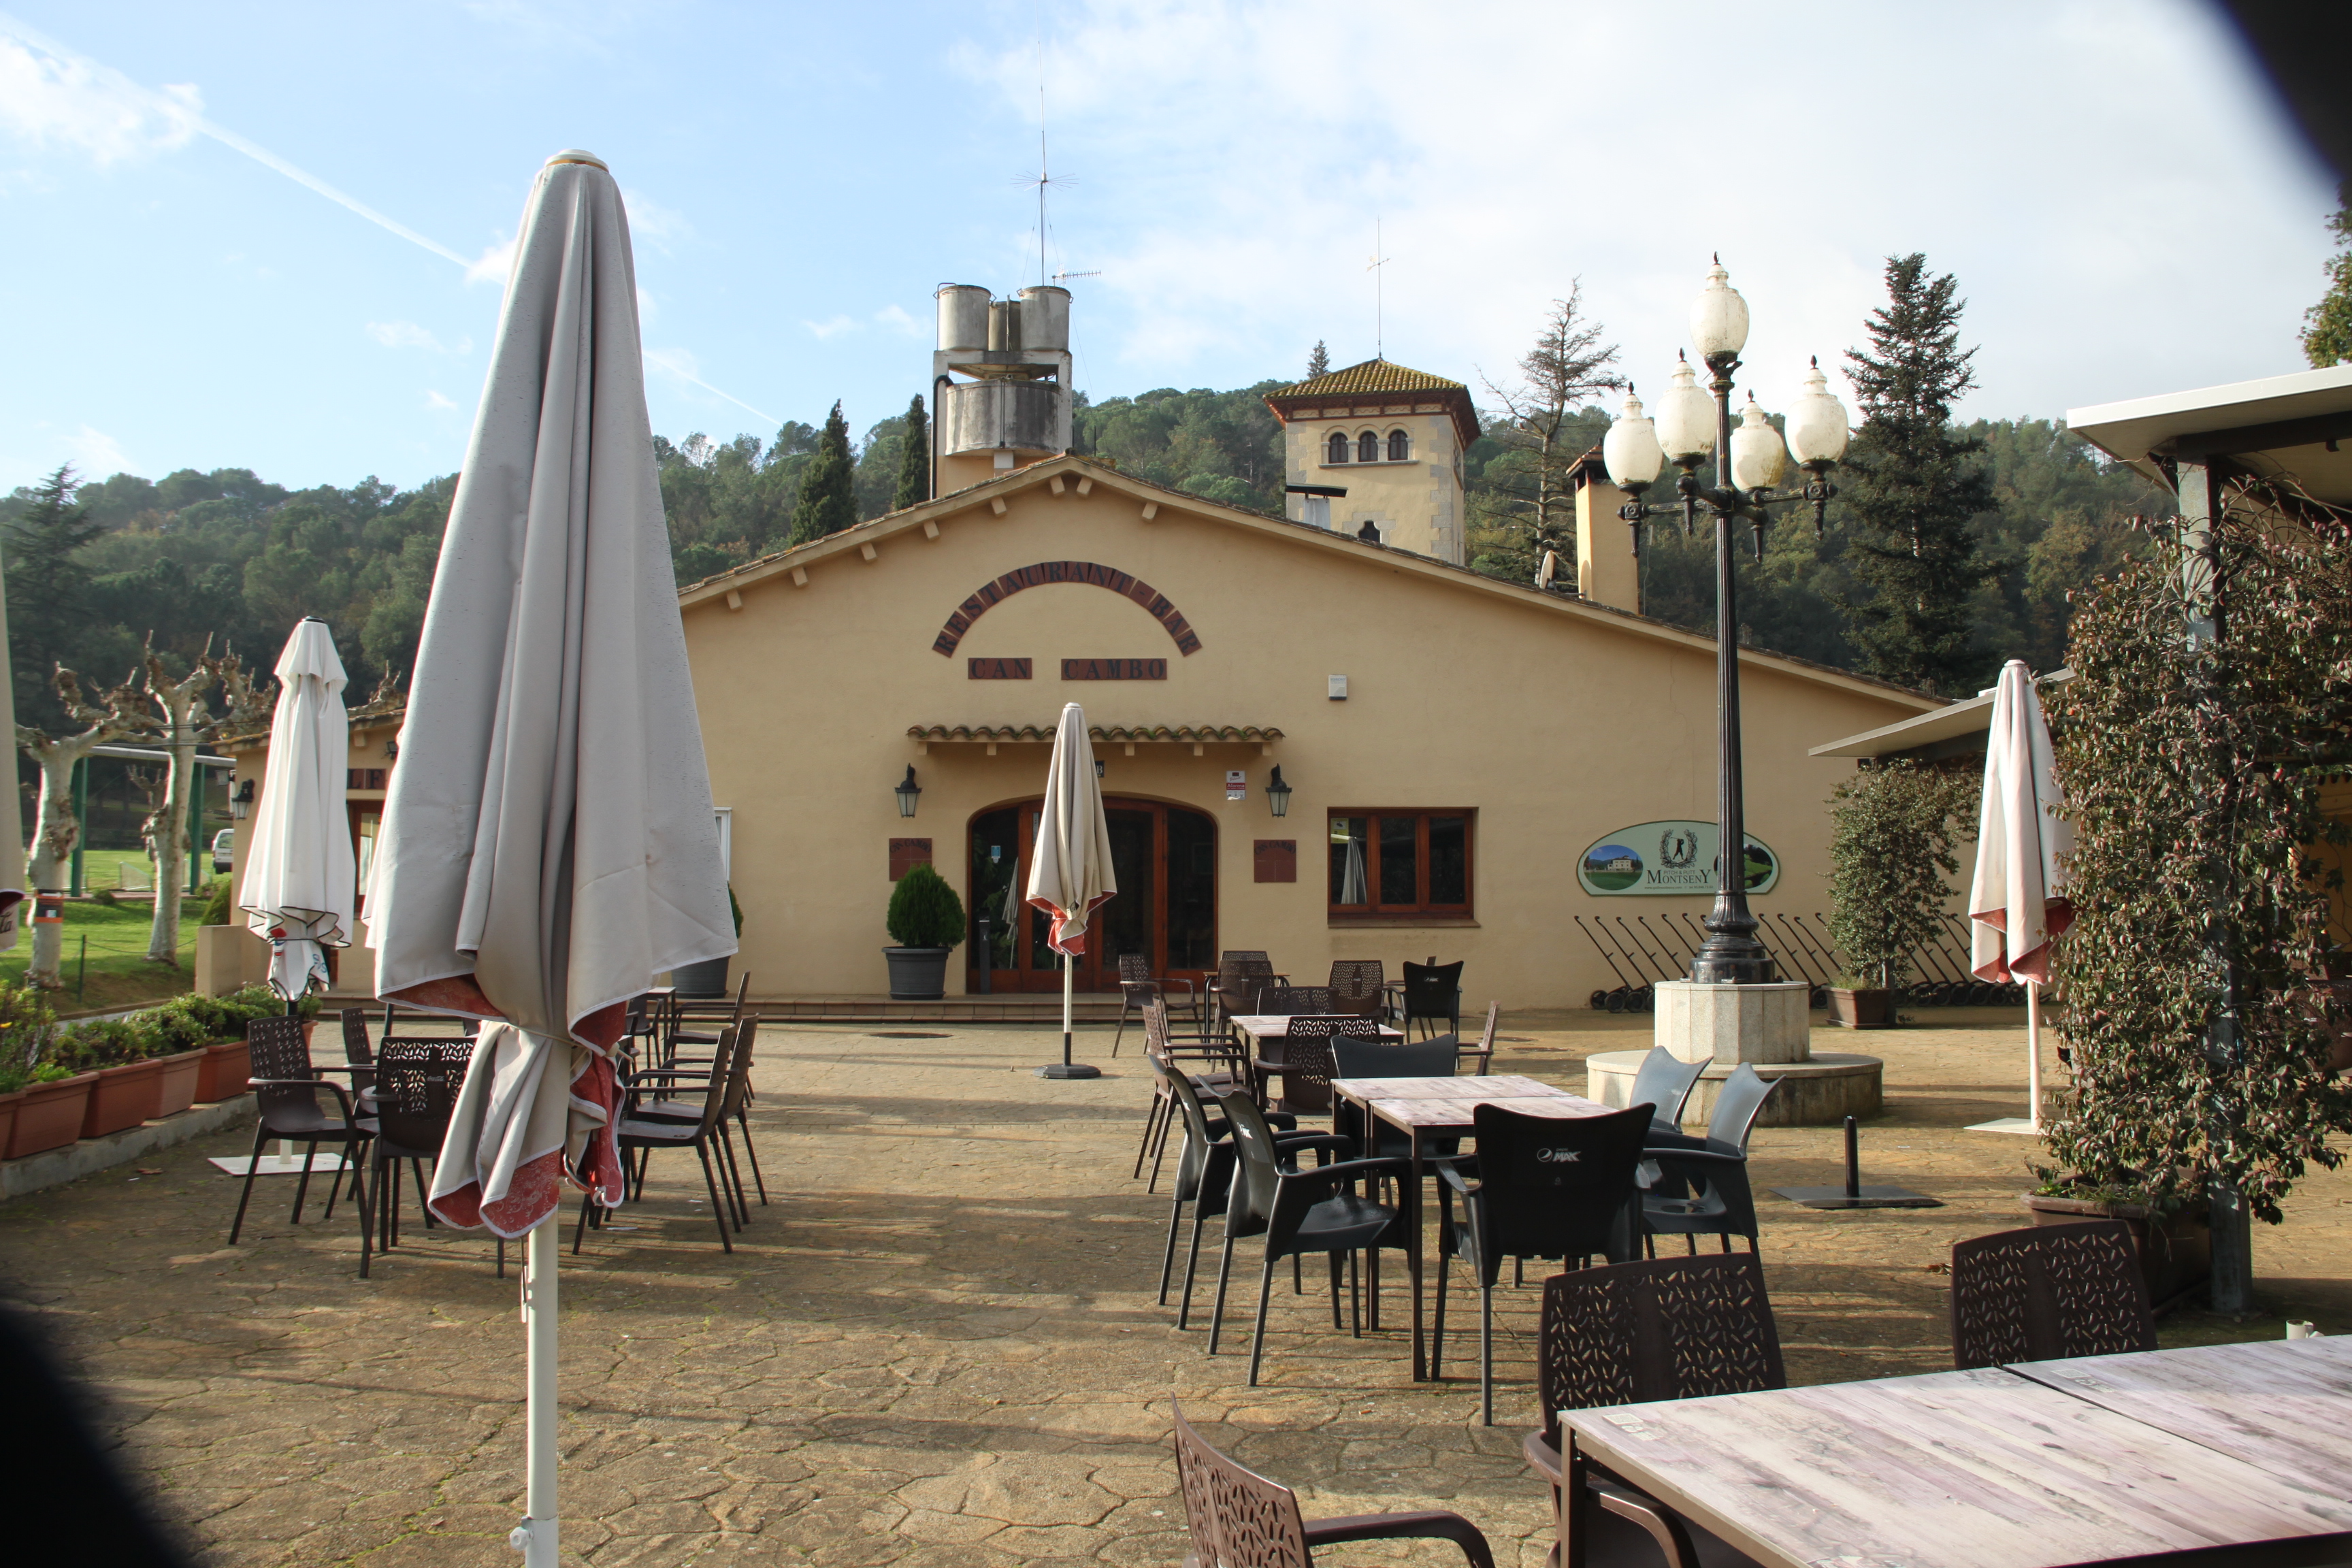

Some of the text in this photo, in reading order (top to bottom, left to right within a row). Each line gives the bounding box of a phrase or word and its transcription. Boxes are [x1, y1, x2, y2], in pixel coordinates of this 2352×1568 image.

[971, 659, 1165, 680] CAN CAMBO
[348, 769, 382, 789] LF
[889, 841, 904, 853] CAN
[1254, 842, 1269, 855] CAN
[1646, 869, 1712, 884] MONTSENY
[1552, 1152, 1581, 1162] MAX
